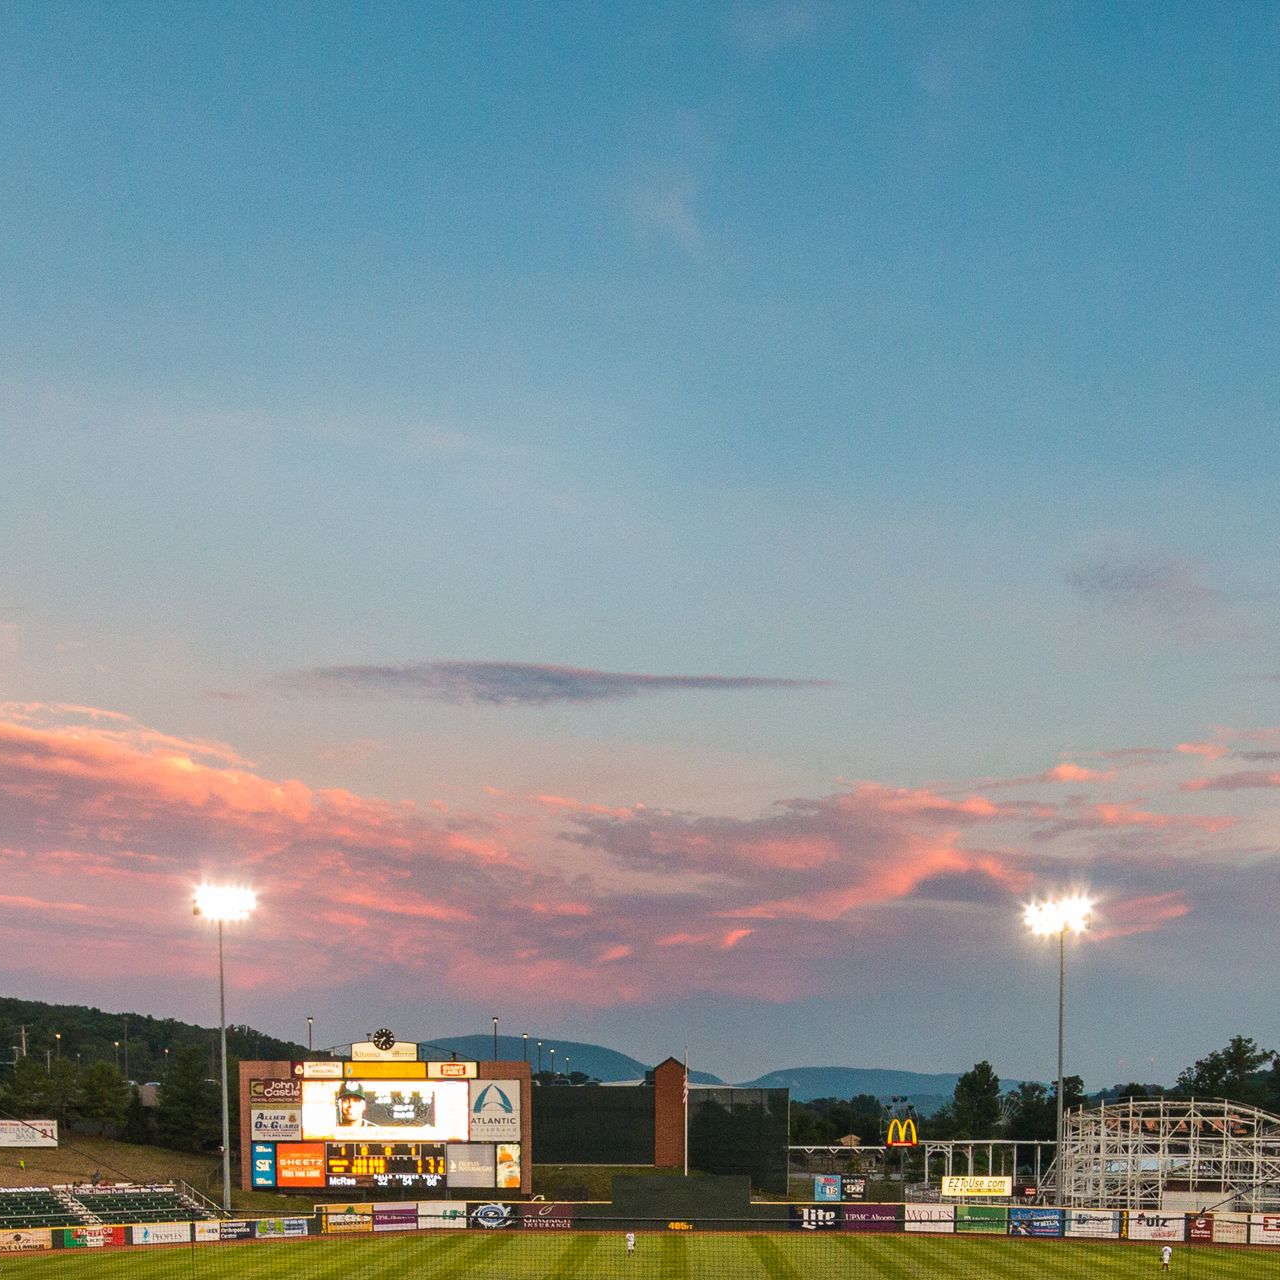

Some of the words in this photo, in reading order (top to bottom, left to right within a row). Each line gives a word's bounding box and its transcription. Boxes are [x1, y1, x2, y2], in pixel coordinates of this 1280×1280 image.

[270, 1081, 294, 1091] John
[264, 1087, 300, 1098] Castle
[471, 1117, 516, 1125] ATLANTIC
[280, 1158, 323, 1166] SHEETZ
[0, 1186, 50, 1194] Junction
[802, 1208, 836, 1230] Lite
[845, 1213, 869, 1221] UPMC
[152, 1232, 183, 1240] PEOPLES
